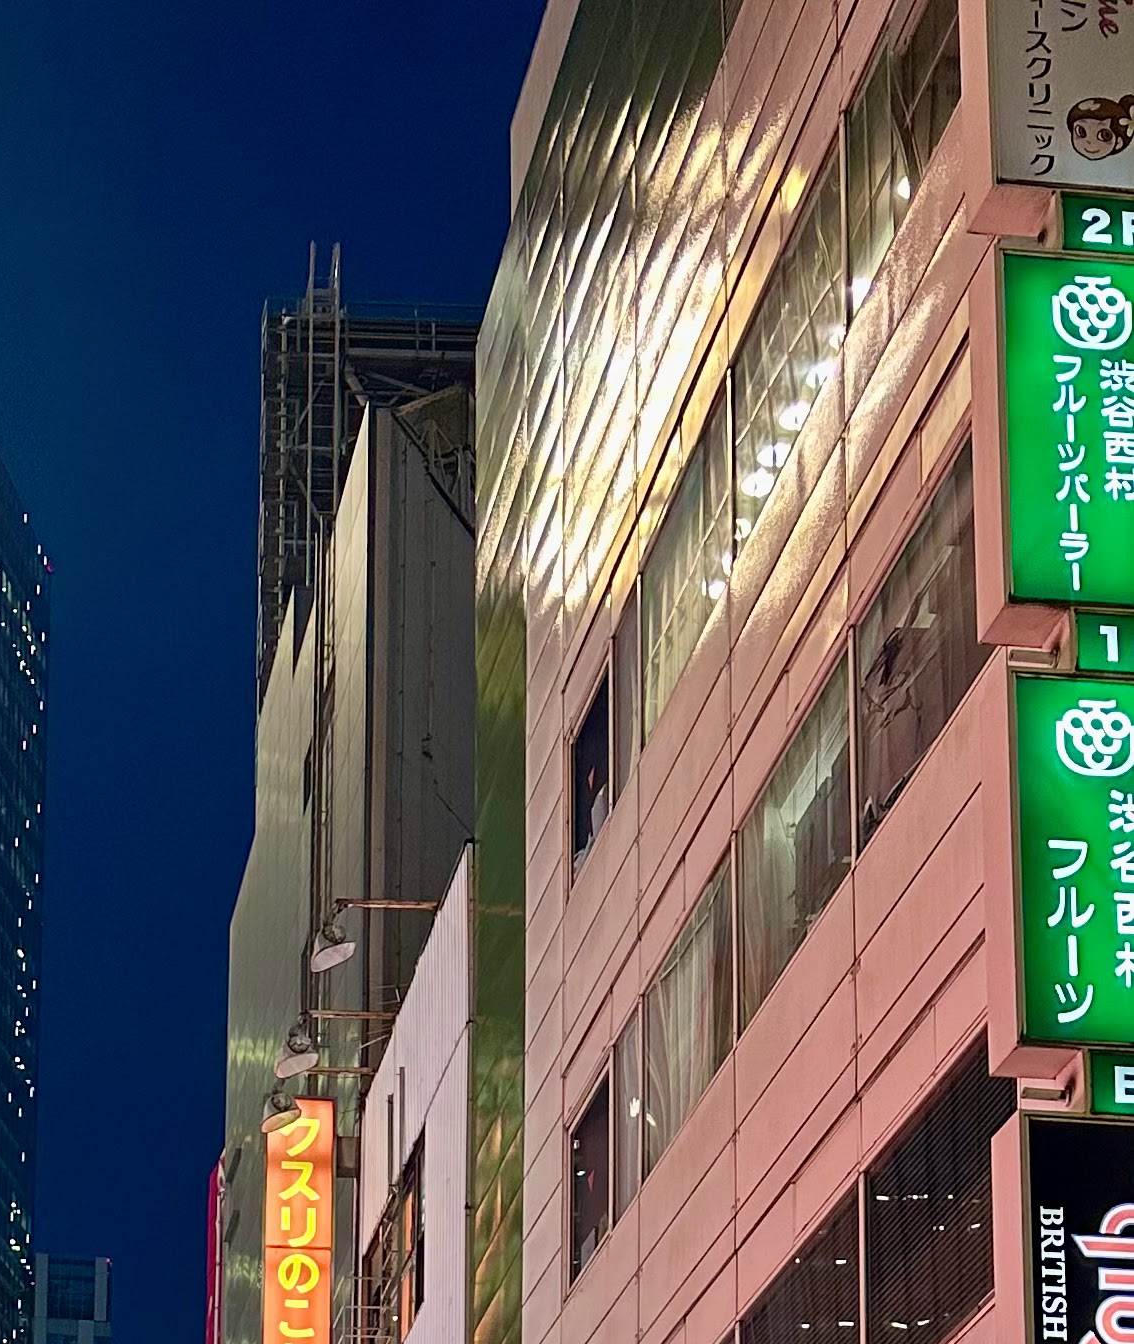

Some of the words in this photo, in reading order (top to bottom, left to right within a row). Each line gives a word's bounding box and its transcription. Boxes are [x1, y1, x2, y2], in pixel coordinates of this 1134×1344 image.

[1052, 354, 1090, 592] フルーツパーラー
[1047, 839, 1095, 1024] フルーツ
[1039, 1205, 1068, 1342] BRITISH
